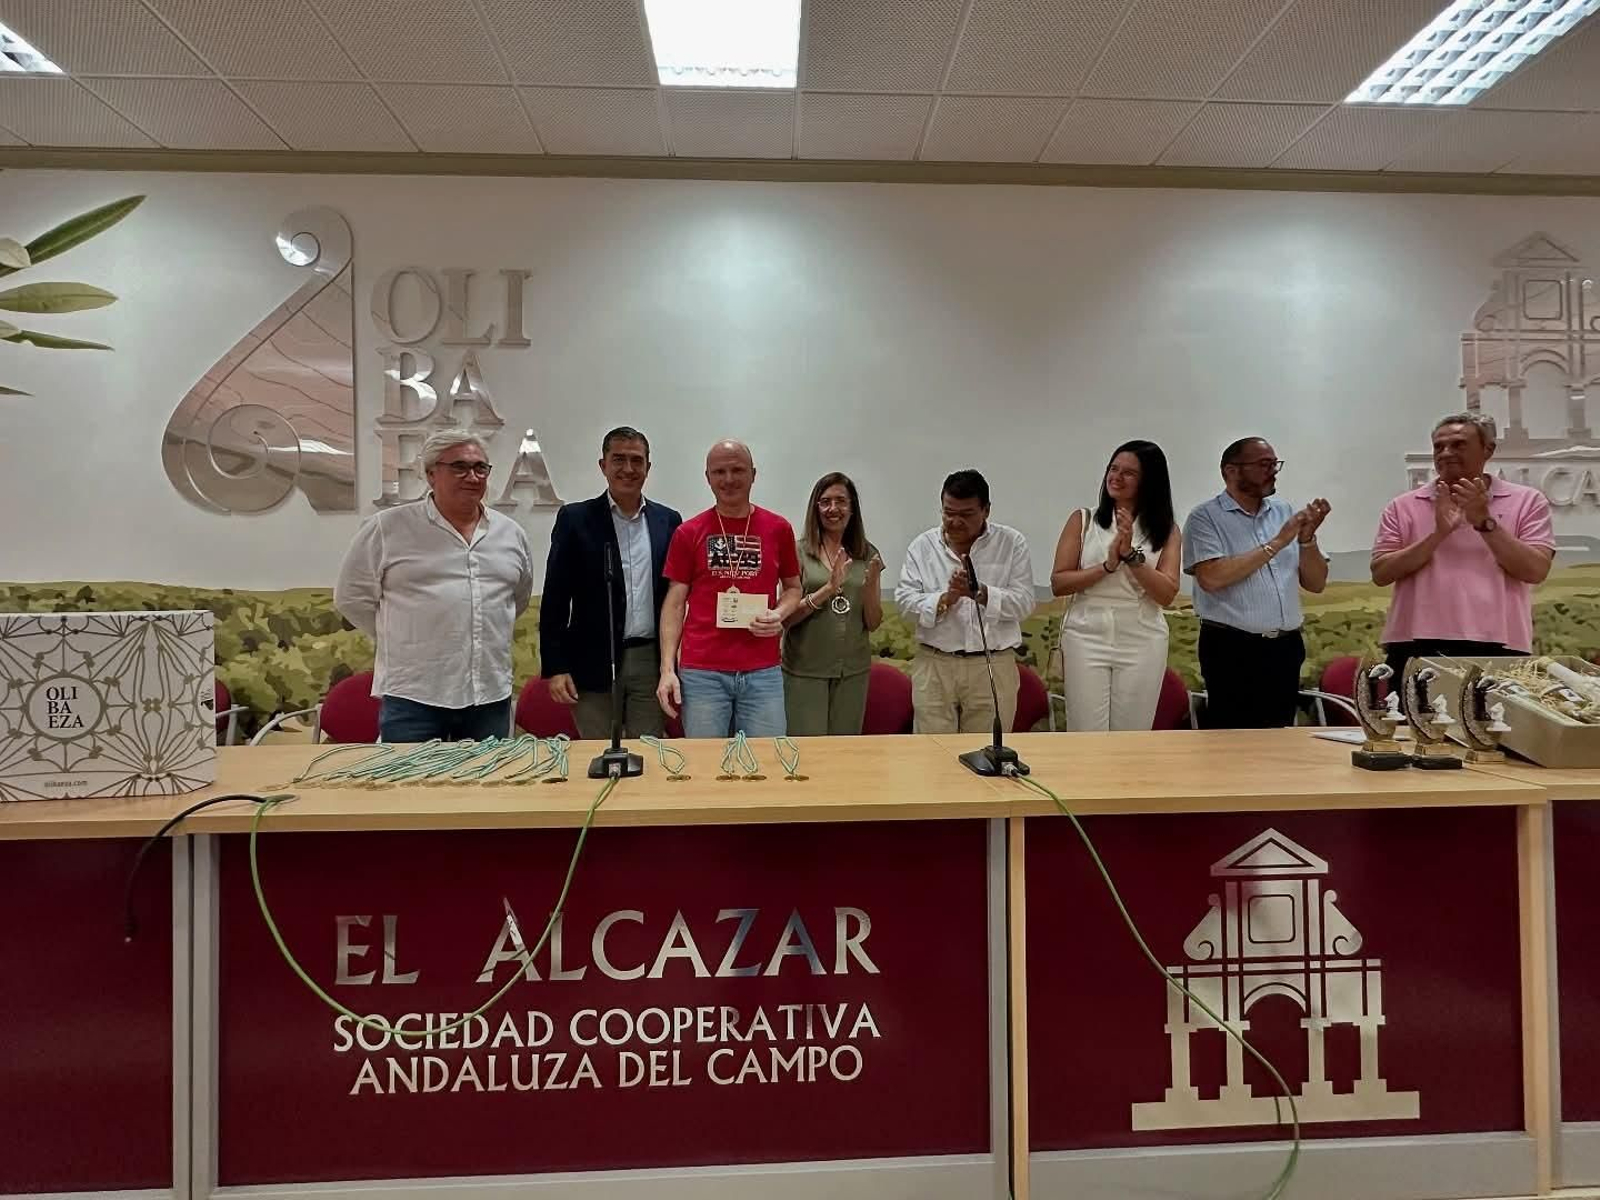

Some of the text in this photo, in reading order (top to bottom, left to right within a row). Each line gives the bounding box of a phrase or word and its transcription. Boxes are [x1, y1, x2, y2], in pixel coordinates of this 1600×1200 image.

[370, 266, 533, 348] OLI
[374, 347, 504, 426] BA
[373, 427, 565, 508] EA
[46, 686, 78, 701] OLI
[47, 700, 72, 714] BA
[48, 714, 84, 729] EZA
[335, 897, 881, 985] EL ALCAZAR
[333, 1002, 881, 1052] SOCIEDAD COOPERATIVA
[348, 1045, 863, 1095] ANDALUZA DEL CAMPO
